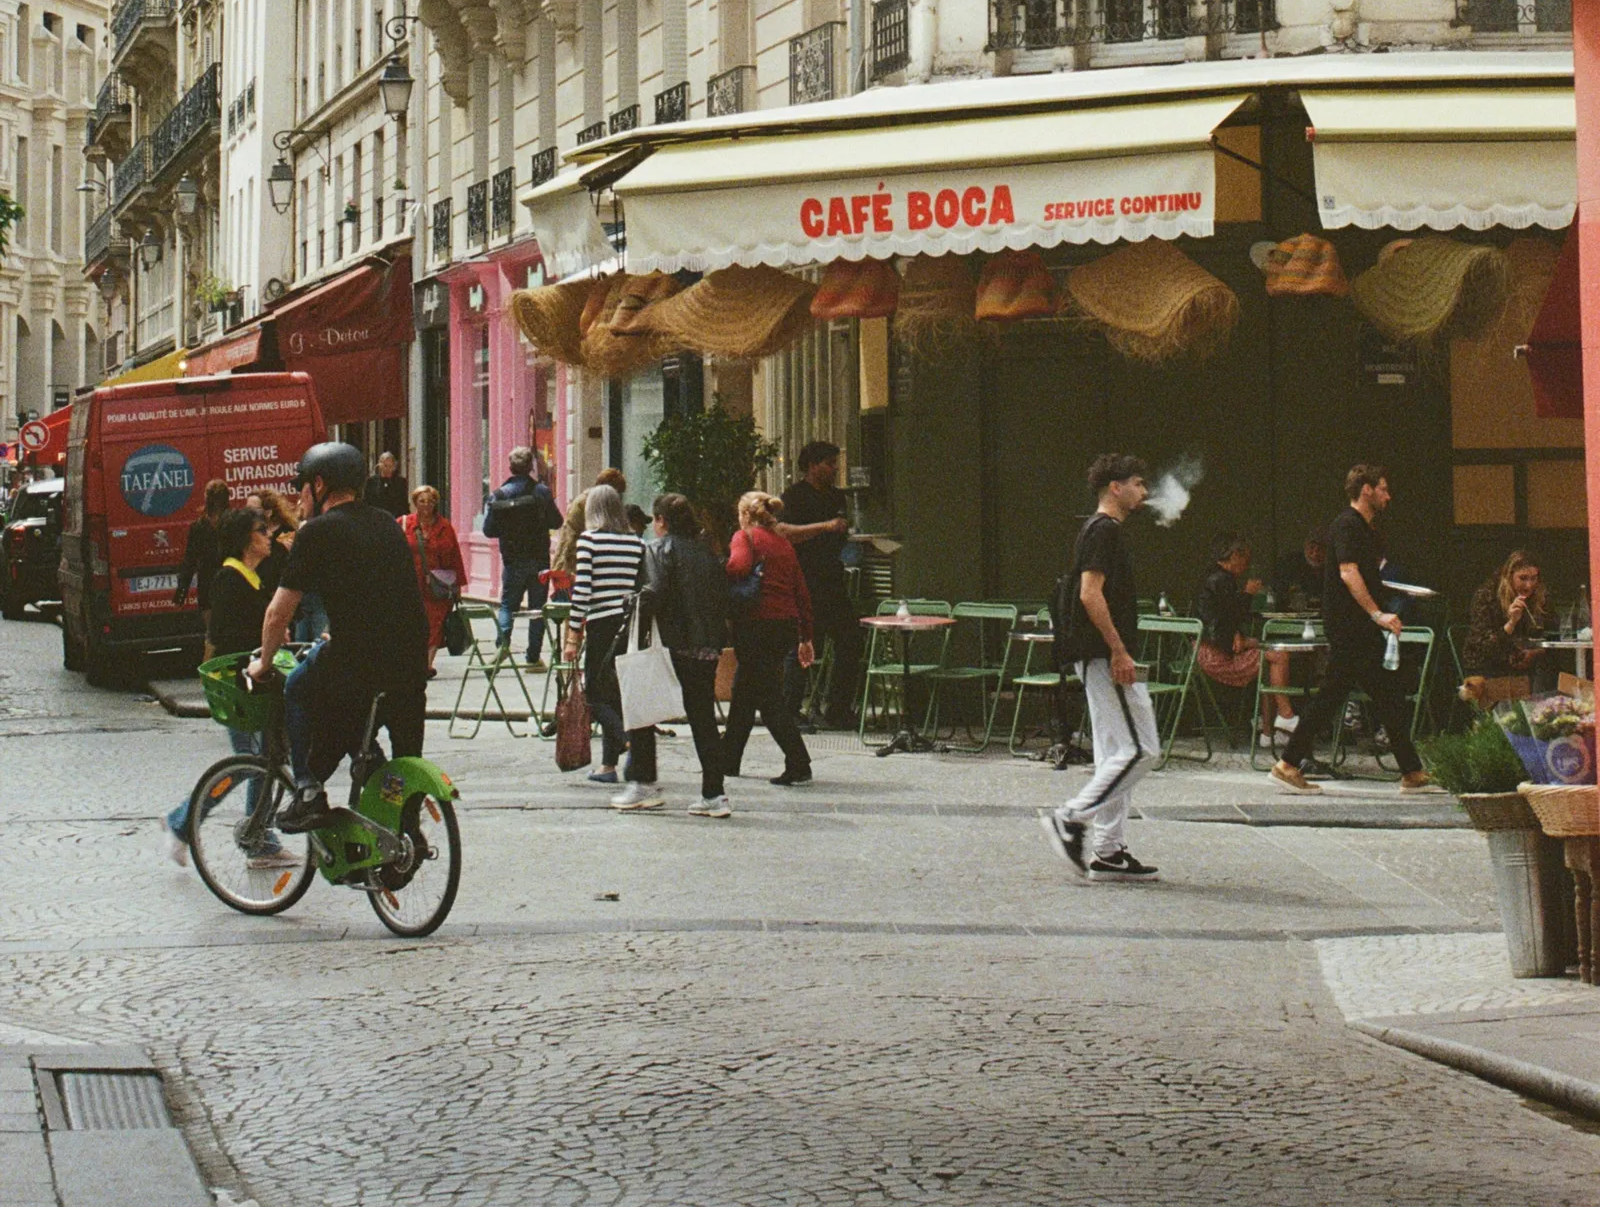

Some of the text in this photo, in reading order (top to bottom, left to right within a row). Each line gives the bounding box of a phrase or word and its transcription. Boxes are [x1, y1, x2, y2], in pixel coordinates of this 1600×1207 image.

[801, 182, 1202, 238] CAFÉ BOCA SERVICE CONTINU
[107, 414, 127, 423] POUR
[128, 413, 138, 422] LA
[138, 409, 168, 421] QUALITÉ
[168, 409, 178, 418] DE
[209, 404, 233, 415] ROULE
[233, 403, 248, 413] AUX
[249, 401, 279, 412] NORMES
[279, 399, 299, 409] EURO
[224, 445, 278, 463] SERVICE
[120, 469, 194, 492] TAFANEL
[225, 461, 301, 482] LIVRAISONS
[228, 481, 300, 500] DÉPANNAG
[137, 575, 180, 589] EJ-771-
